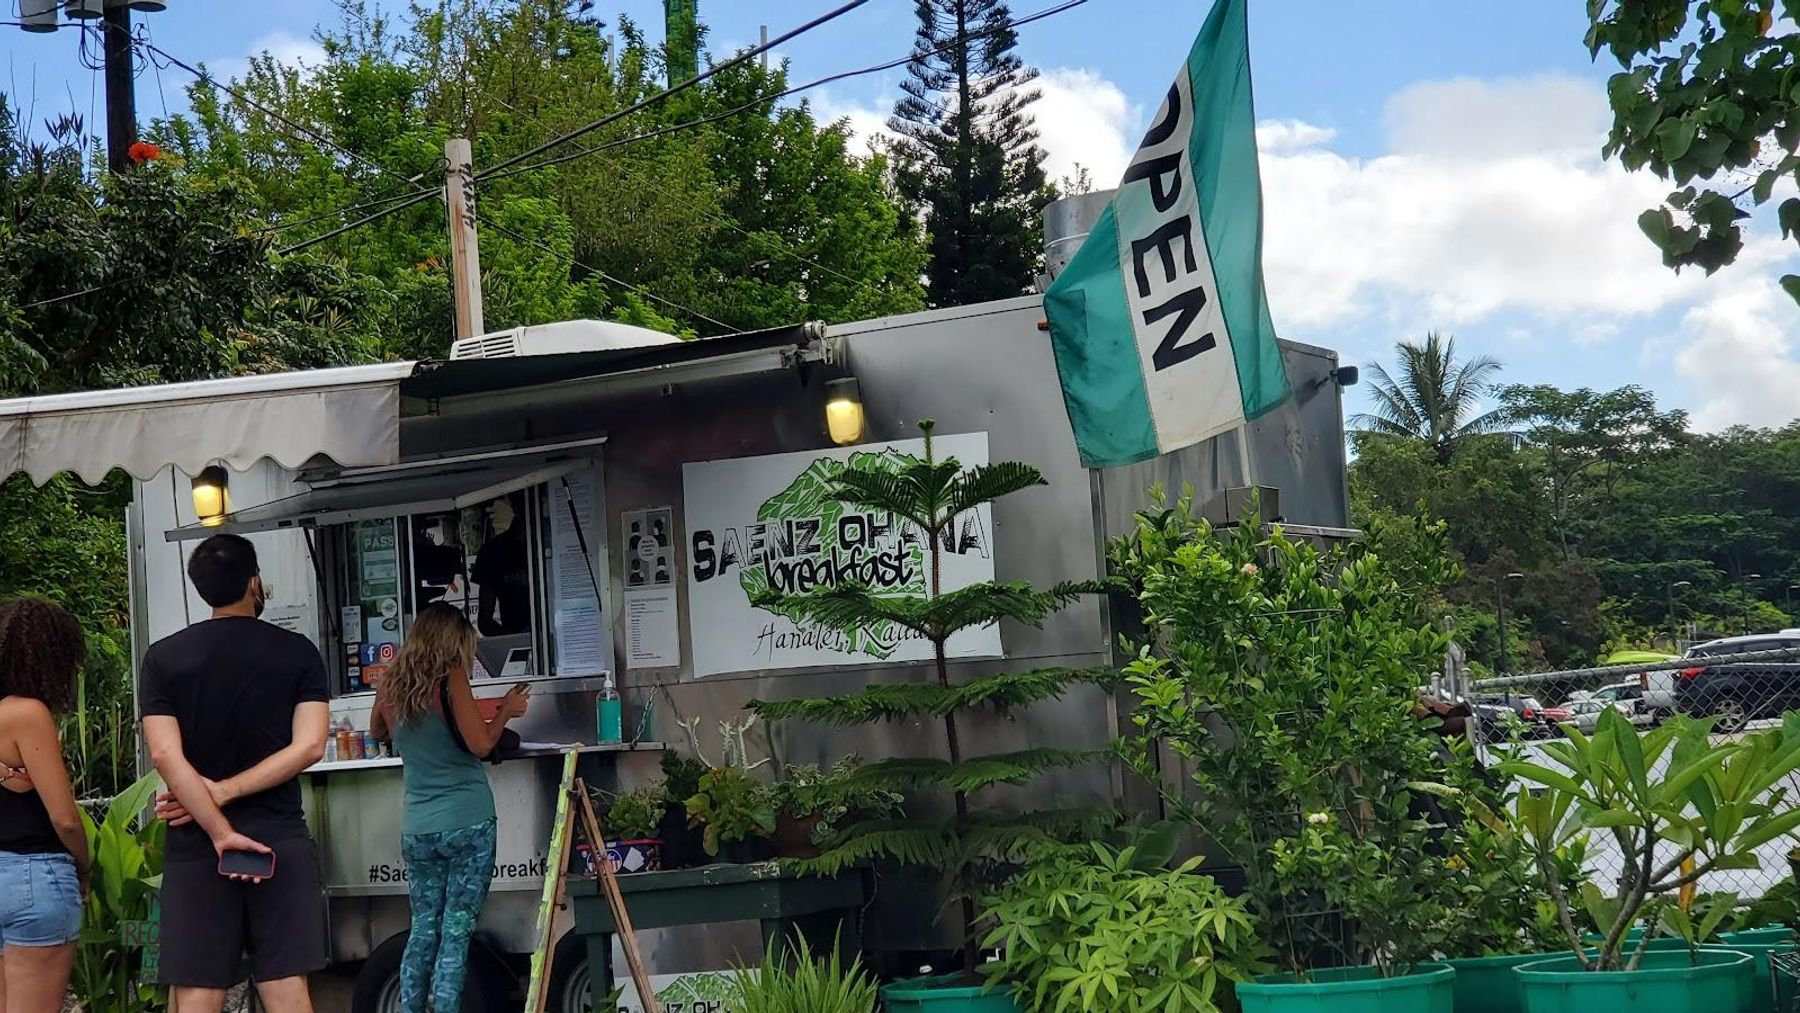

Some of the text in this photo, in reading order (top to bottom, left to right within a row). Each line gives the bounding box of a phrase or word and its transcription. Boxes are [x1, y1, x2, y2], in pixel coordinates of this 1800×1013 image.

[364, 535, 394, 550] PASS
[692, 503, 990, 582] SAENZ OHANA
[764, 538, 914, 594] breakfast
[856, 618, 926, 651] Kaua
